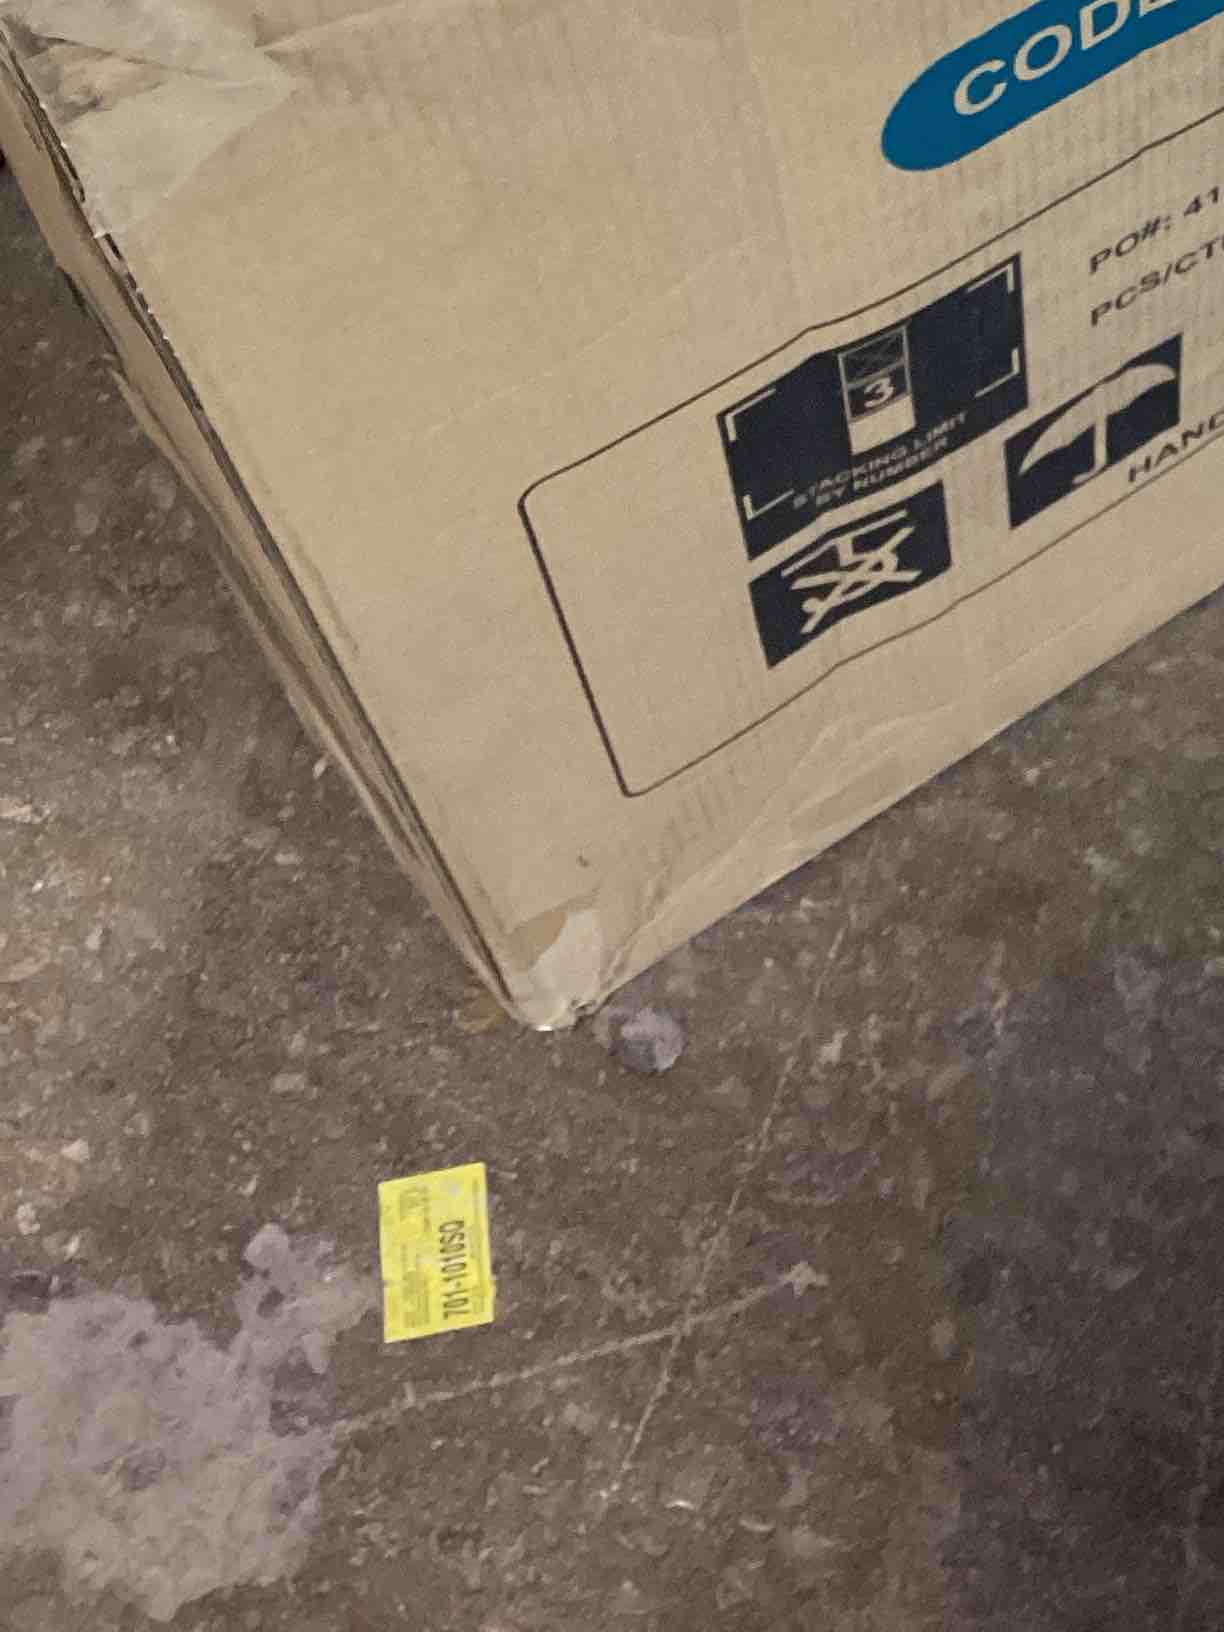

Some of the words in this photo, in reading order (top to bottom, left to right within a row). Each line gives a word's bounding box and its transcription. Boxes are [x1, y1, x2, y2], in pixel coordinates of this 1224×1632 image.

[1088, 206, 1176, 274] PO#:
[862, 374, 897, 406] 3
[913, 410, 967, 451] LIMIT
